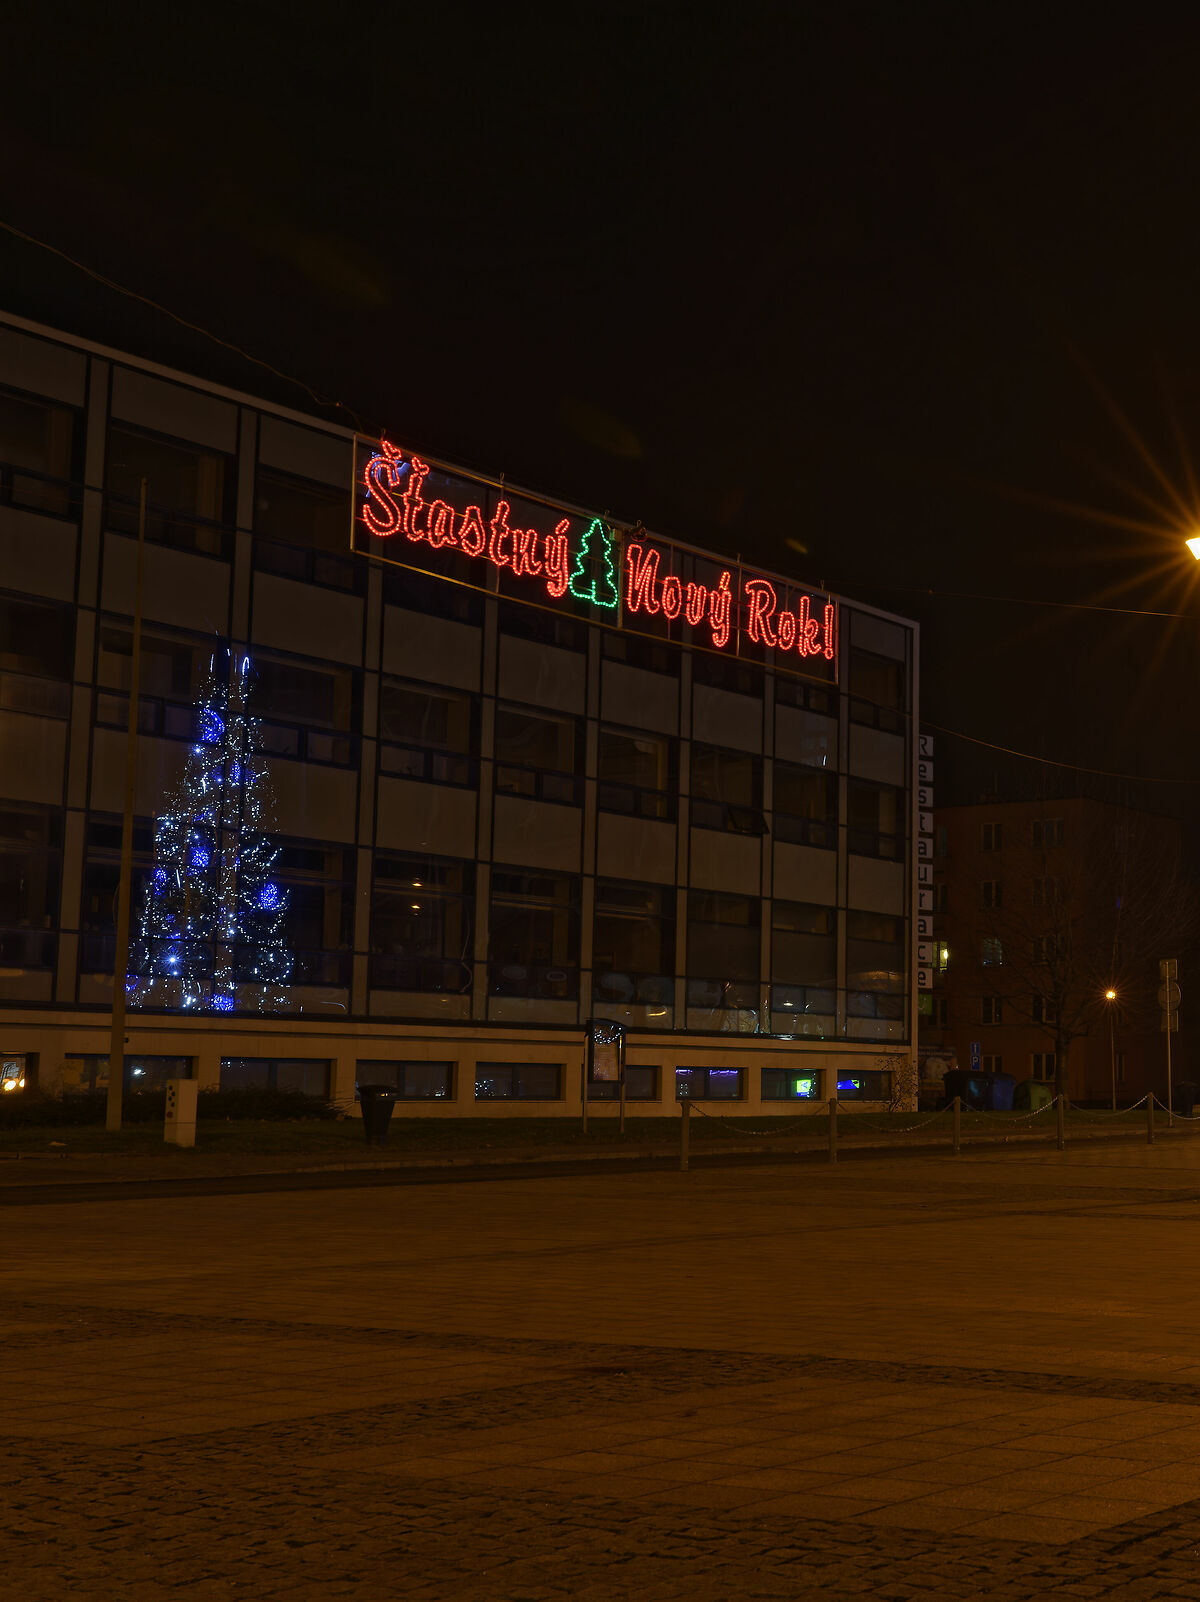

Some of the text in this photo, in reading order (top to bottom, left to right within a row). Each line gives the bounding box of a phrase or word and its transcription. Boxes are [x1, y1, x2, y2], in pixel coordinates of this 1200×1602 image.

[362, 440, 836, 660] Šťastný Nový Rok!
[918, 736, 929, 986] Restaurace
